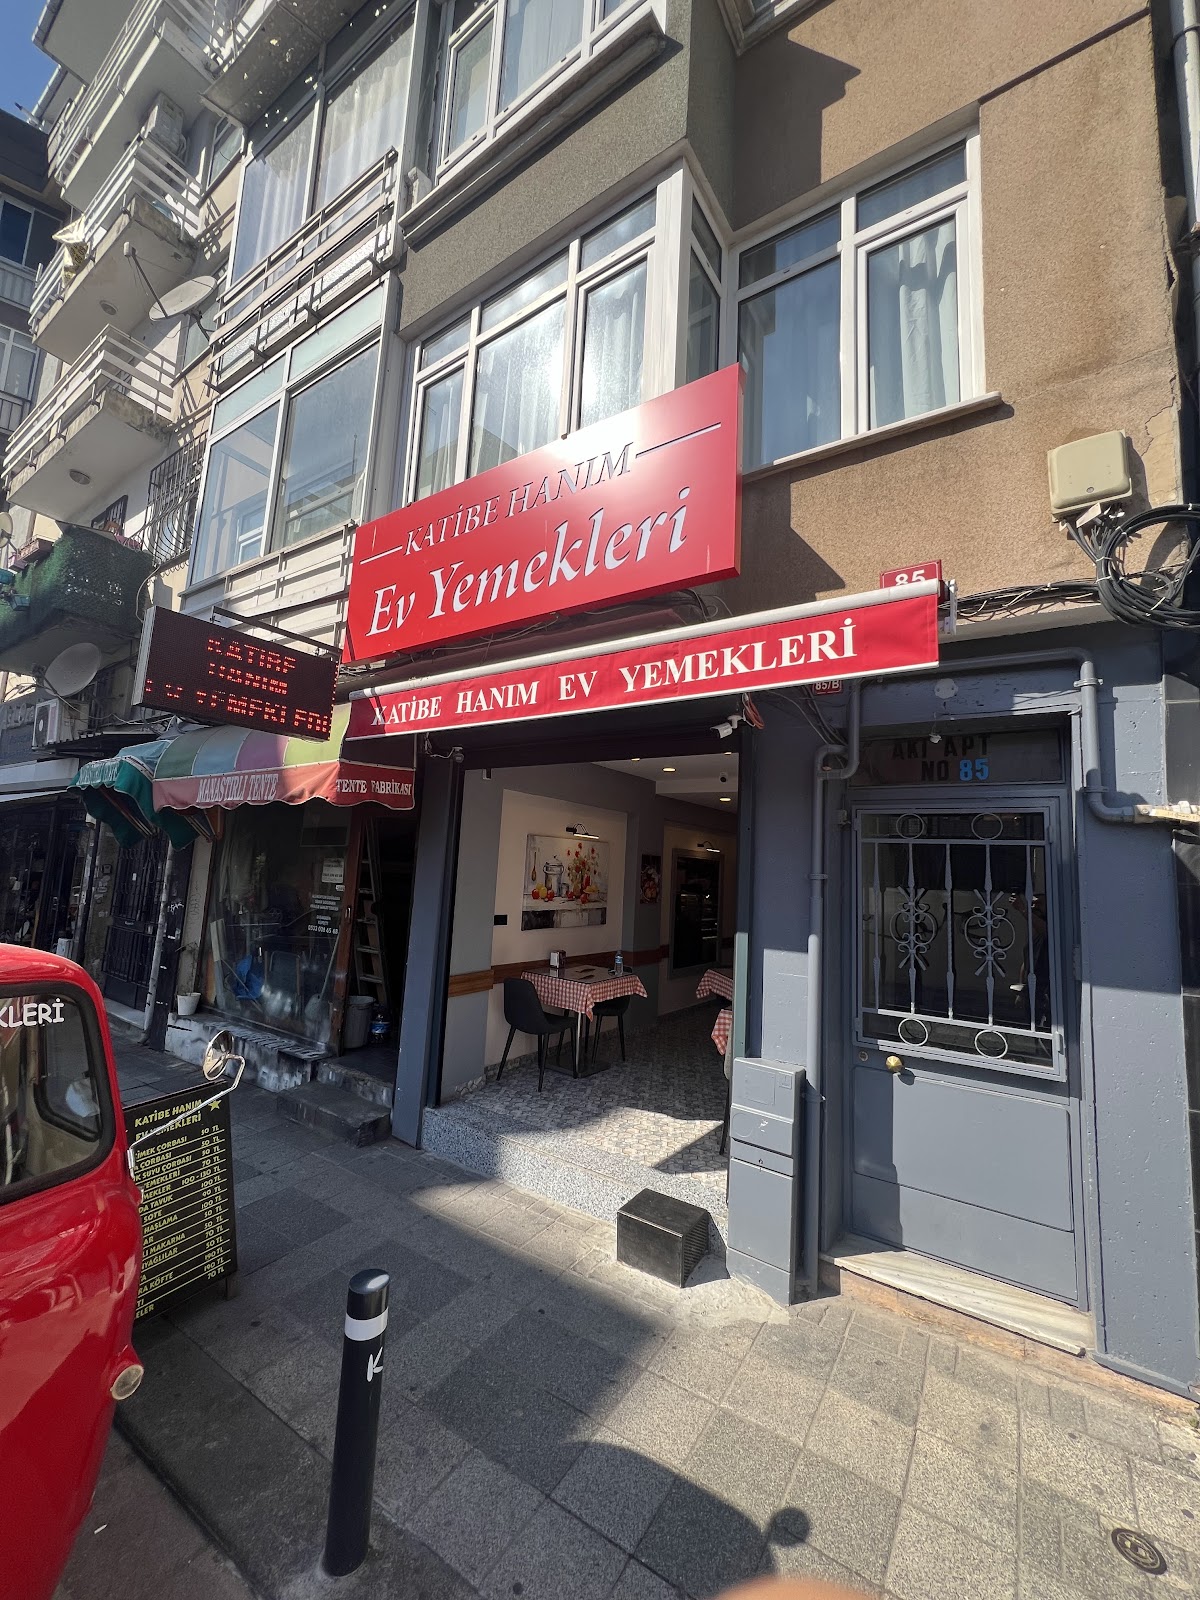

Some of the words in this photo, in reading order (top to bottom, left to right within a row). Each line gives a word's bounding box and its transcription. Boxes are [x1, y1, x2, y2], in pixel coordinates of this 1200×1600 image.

[402, 494, 502, 556] KATİBE
[506, 442, 634, 517] HANIM
[365, 583, 416, 637] Ev
[428, 486, 691, 620] Yemekleri
[454, 680, 540, 714] HANIM
[558, 669, 598, 702] EV
[618, 617, 858, 694] YEMEKLERİ
[921, 760, 949, 781] NO
[959, 757, 990, 782] 85
[247, 773, 279, 801] TENTE
[336, 779, 367, 794] TENTE
[371, 779, 412, 796] FABRİKASI
[135, 1109, 171, 1128] KATİBE
[157, 1136, 188, 1152] ÇORBASI
[140, 1152, 172, 1169] ÇORBASI
[162, 1155, 192, 1173] ÇORBASI
[181, 1175, 195, 1186] 100
[150, 1195, 173, 1208] TAVUK
[201, 1179, 213, 1188] 100
[144, 1214, 178, 1234] HAŞLAMA
[201, 1200, 213, 1209] 100
[216, 1225, 223, 1233] TL
[150, 1233, 186, 1253] MAKARNA
[217, 1257, 224, 1265] TL
[217, 1266, 225, 1274] TL
